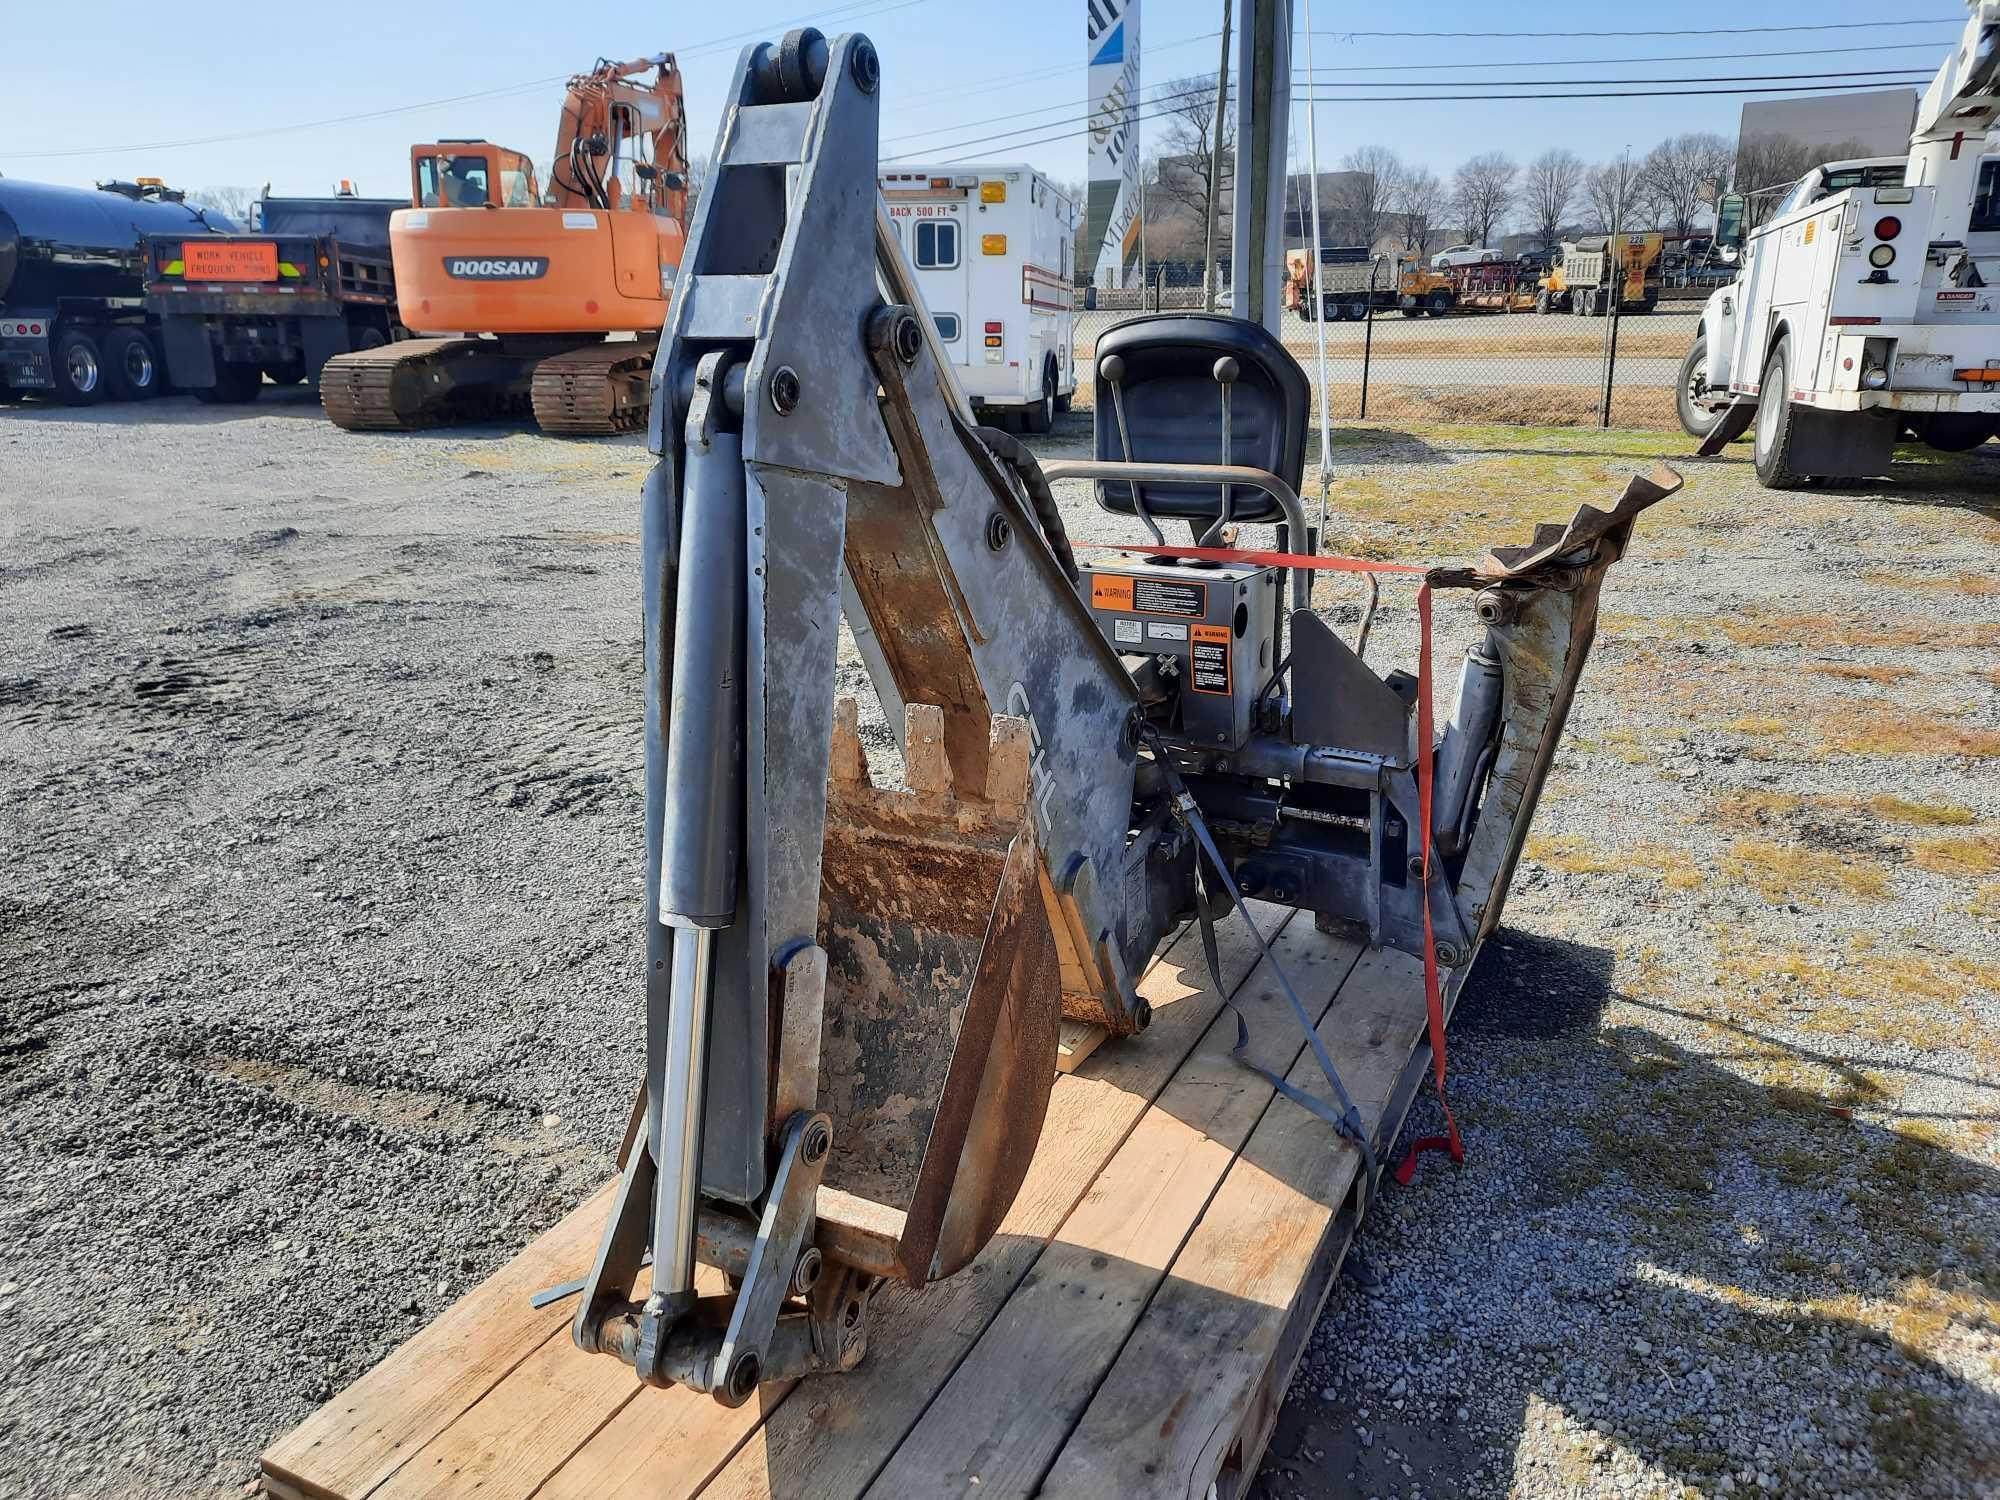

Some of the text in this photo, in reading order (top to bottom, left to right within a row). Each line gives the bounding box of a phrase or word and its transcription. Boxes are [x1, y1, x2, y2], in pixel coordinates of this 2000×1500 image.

[890, 207, 912, 217] BACK
[916, 207, 933, 217] 500
[196, 250, 264, 261] WORK VEHICLE
[191, 263, 236, 274] FREQUENT
[452, 260, 538, 275] DOOSAN
[1104, 588, 1131, 599] WARNING
[1204, 629, 1228, 639] WARNING
